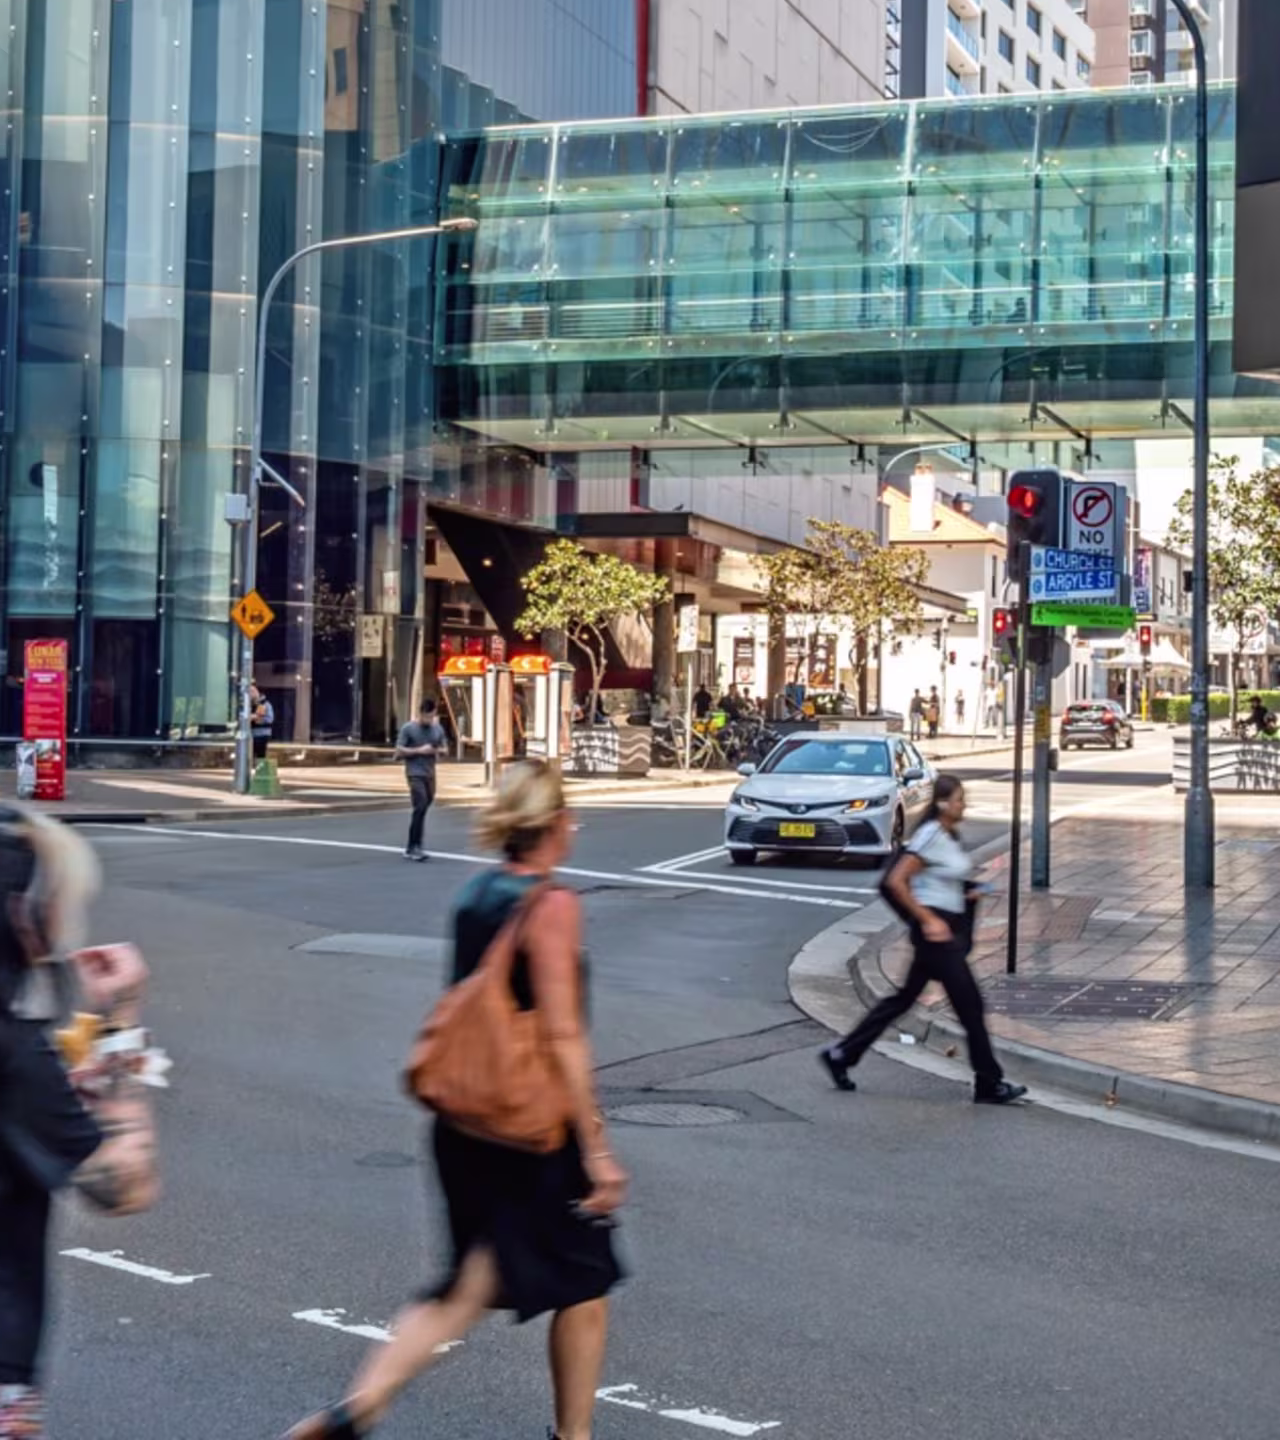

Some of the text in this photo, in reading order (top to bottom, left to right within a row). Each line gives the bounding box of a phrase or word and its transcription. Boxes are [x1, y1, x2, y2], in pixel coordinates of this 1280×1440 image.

[1079, 530, 1104, 545] NO
[1046, 550, 1095, 570] CHURCH
[1047, 571, 1114, 591] ARGYLE ST
